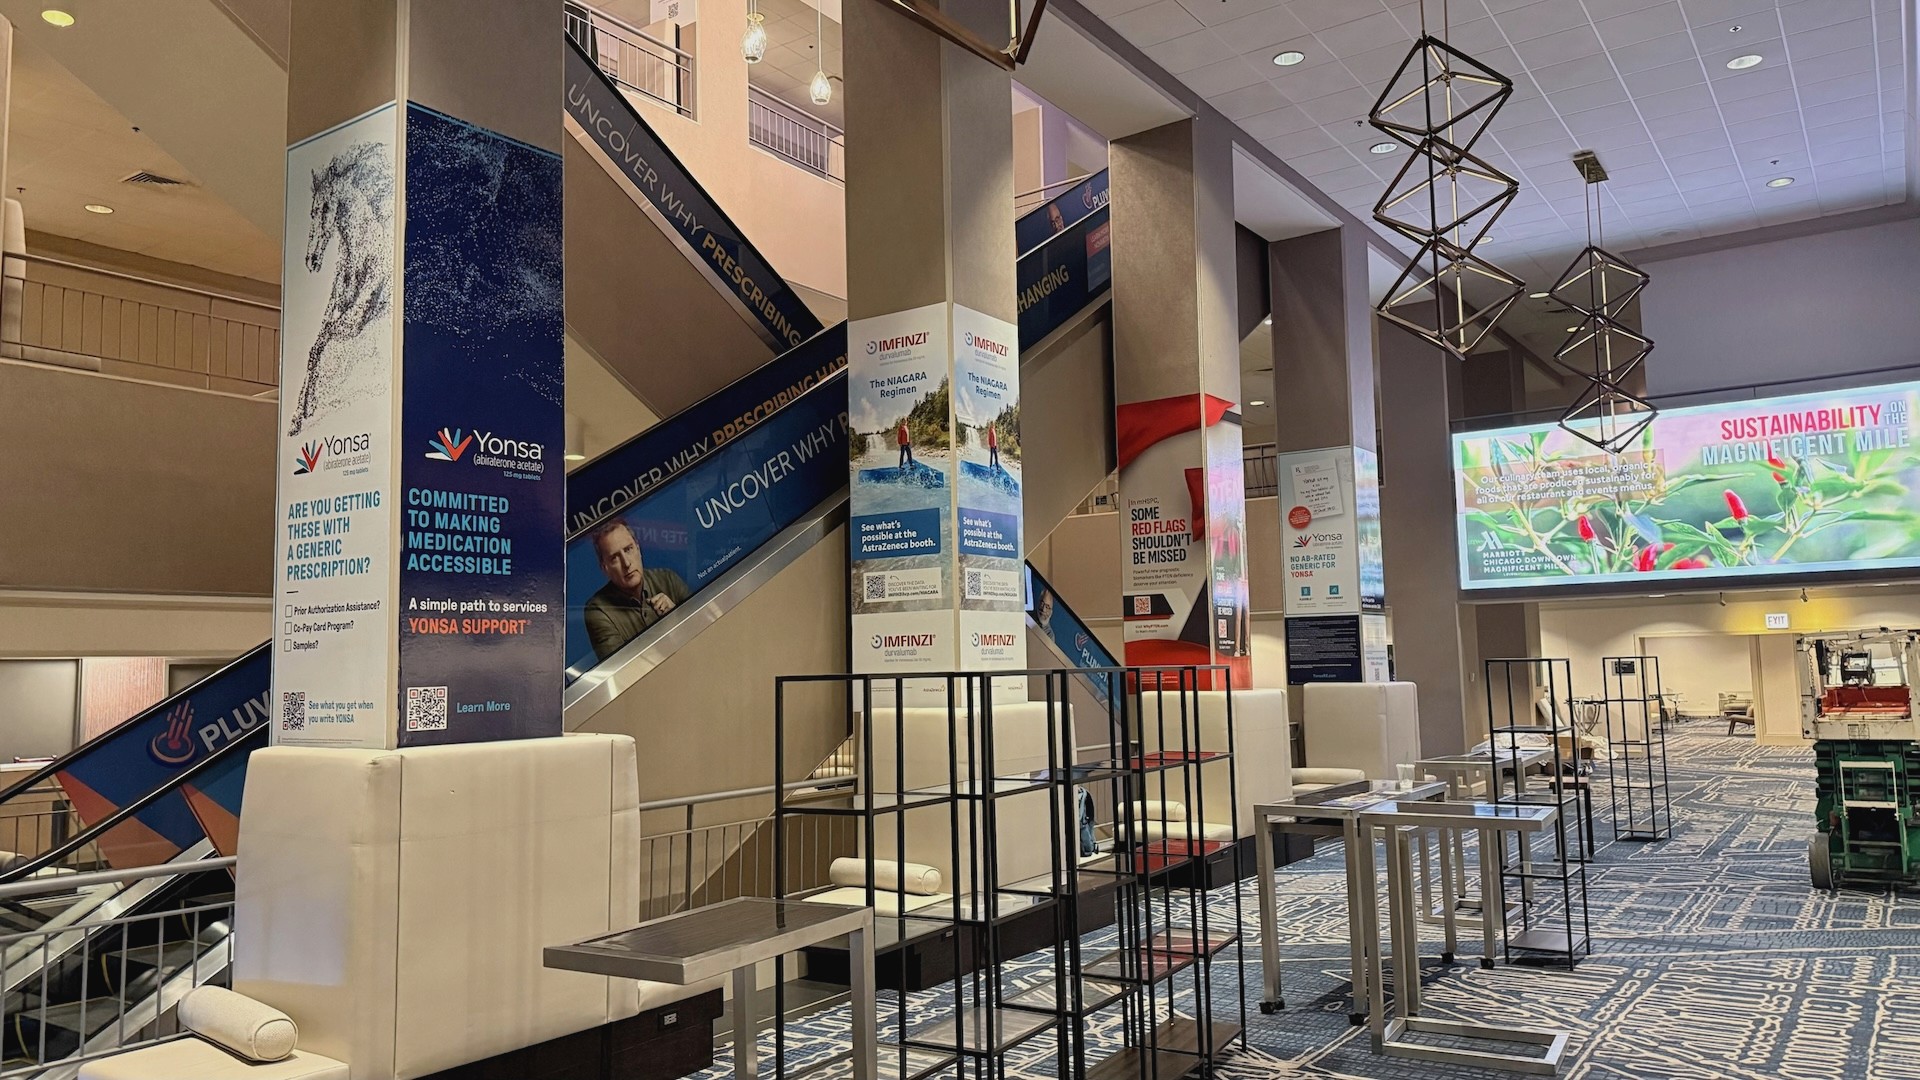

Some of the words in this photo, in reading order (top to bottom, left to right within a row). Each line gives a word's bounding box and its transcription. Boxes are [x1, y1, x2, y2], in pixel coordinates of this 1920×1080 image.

[1092, 188, 1109, 208] PLUV
[568, 84, 657, 191] UNCOVER
[660, 184, 704, 236] WHY
[702, 233, 802, 347] PRESCRIBING
[1017, 265, 1069, 314] HANGING
[870, 379, 885, 389] The
[887, 372, 927, 385] NIAGARA
[968, 372, 979, 383] The
[981, 377, 1008, 391] NIAGARA
[880, 385, 917, 399] Regimen
[976, 385, 1001, 399] Regimen
[1890, 401, 1906, 412] ON
[1721, 404, 1881, 440] SUSTAINABILITY
[1885, 412, 1907, 425] THE
[1703, 433, 1846, 465] MAGNIFICENT
[1856, 427, 1910, 451] MILE
[473, 453, 516, 469] (abiraterone
[517, 460, 544, 473] acetate)
[695, 451, 795, 529] UNCOVER
[792, 419, 836, 464] WHY
[1500, 472, 1534, 483] culinary
[1537, 471, 1560, 479] team
[1562, 469, 1583, 477] uses
[1585, 465, 1610, 475] local,
[1612, 463, 1648, 474] organic
[1475, 486, 1501, 494] foods
[1503, 484, 1521, 492] that
[1540, 479, 1583, 491] produced
[1585, 473, 1638, 485] sustainably
[1641, 471, 1655, 480] for
[409, 488, 509, 514] COMMITTED
[1477, 496, 1487, 504] all
[1517, 490, 1565, 501] restaurant
[1585, 485, 1618, 495] events
[1620, 482, 1655, 492] menus.
[288, 502, 307, 520] ARE
[311, 498, 331, 516] YOU
[335, 491, 380, 513] GETTING
[1132, 507, 1159, 521] SOME
[288, 521, 320, 540] THESE
[323, 517, 350, 536] WITH
[408, 509, 429, 528] TO
[435, 512, 500, 533] MAKING
[861, 523, 874, 531] See
[876, 520, 901, 530] what's
[963, 516, 973, 525] See
[974, 518, 991, 528] what's
[1132, 522, 1151, 536] RED
[1154, 519, 1185, 534] FLAGS
[408, 531, 511, 554] MEDICATION
[862, 531, 893, 543] possible
[904, 529, 917, 538] the
[964, 529, 986, 538] possible
[994, 531, 1002, 540] the
[1133, 533, 1191, 550] SHOULDN'T
[287, 545, 294, 560] A
[297, 539, 342, 559] GENERIC
[862, 541, 908, 553] AstraZeneca
[910, 538, 936, 547] booth.
[964, 539, 997, 550] AstraZeneca
[407, 553, 511, 575] ACCESSIBLE
[1133, 552, 1145, 564] BE
[1148, 549, 1186, 564] MISSED
[287, 557, 370, 581] PRESCRIPTION?
[697, 570, 707, 580] Not
[1484, 564, 1541, 573] MAGNIFICENT
[294, 605, 307, 615] Prior
[308, 603, 345, 614] Authorization
[346, 600, 380, 611] Assistance?
[409, 598, 417, 610] A
[420, 598, 457, 613] simple
[460, 600, 485, 613] path
[489, 600, 500, 612] to
[503, 601, 547, 613] services
[293, 624, 312, 634] Co-Pay
[313, 622, 326, 632] Card
[327, 621, 354, 631] Program?
[409, 617, 459, 634] YONSA
[293, 640, 318, 651] Samples?
[309, 701, 319, 709] See
[320, 701, 335, 710] what
[336, 703, 346, 712] you
[347, 701, 357, 712] get
[358, 701, 373, 709] when
[457, 702, 484, 713] Learn
[487, 701, 510, 712] More
[198, 688, 271, 753] PLUV
[308, 715, 318, 725] you
[320, 714, 334, 723] write
[336, 714, 354, 723] YONSA
